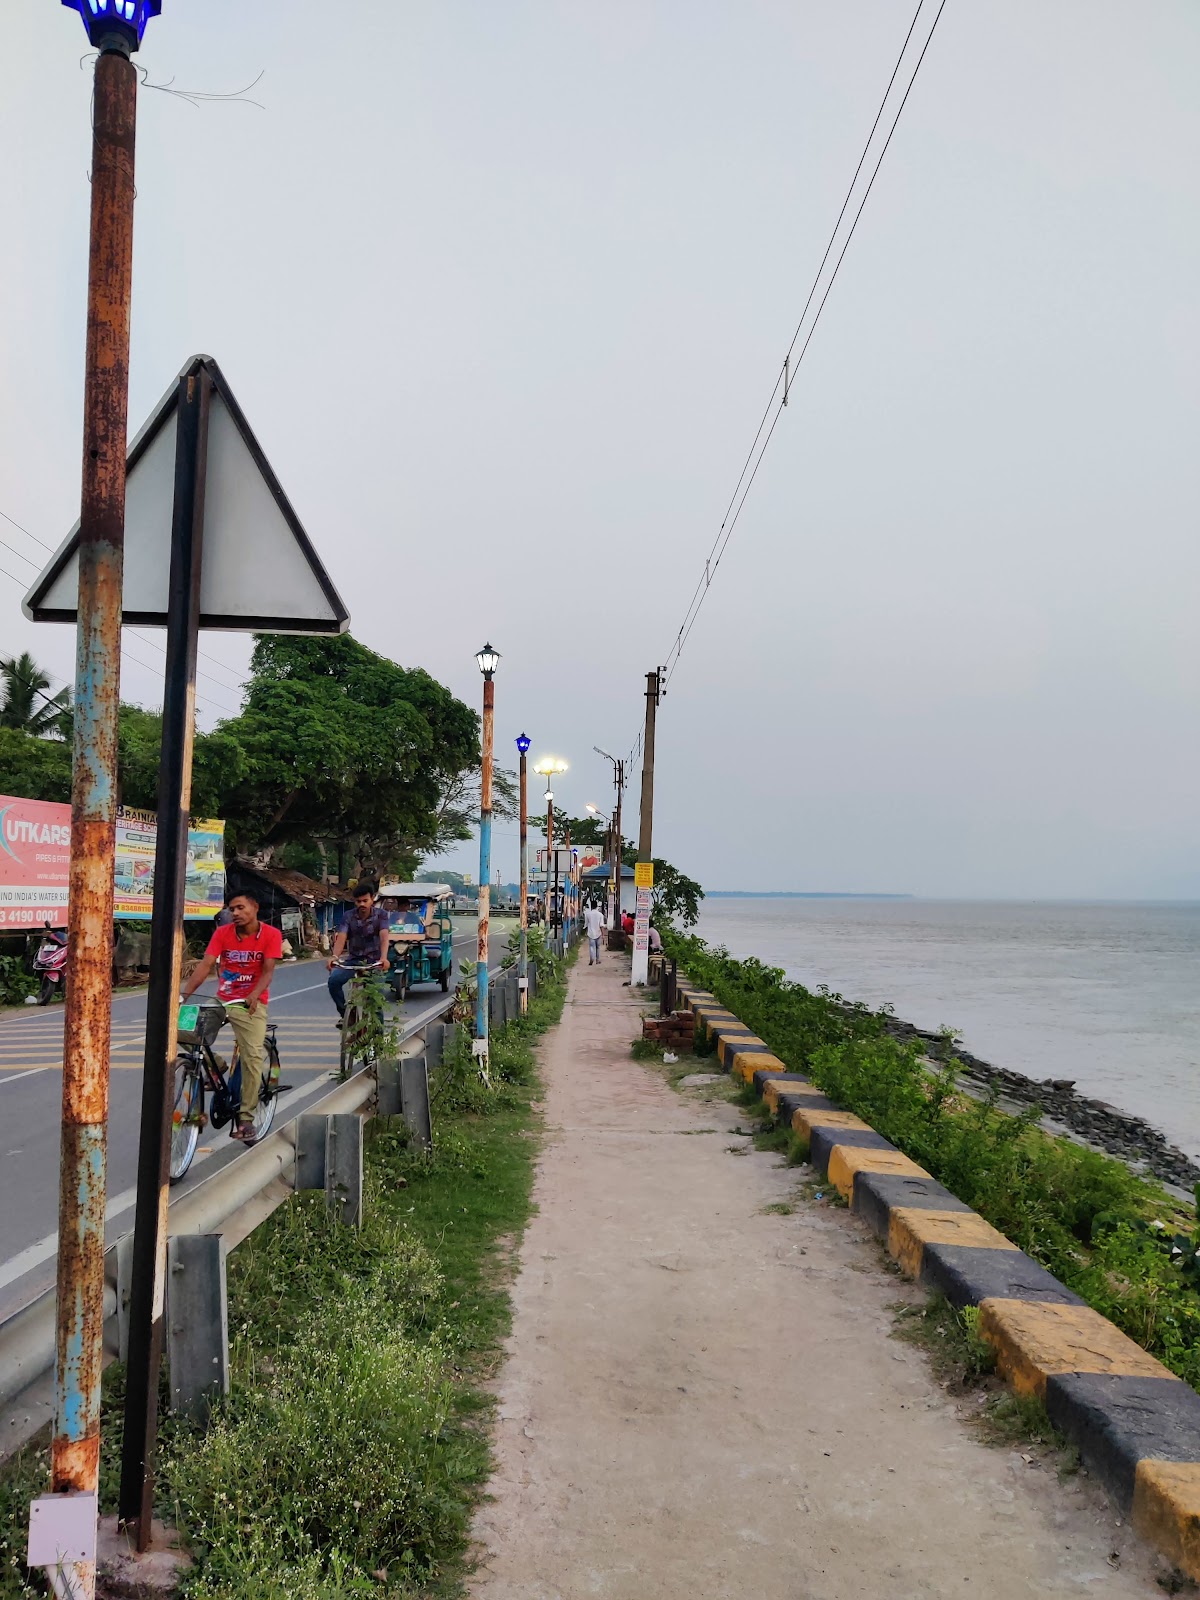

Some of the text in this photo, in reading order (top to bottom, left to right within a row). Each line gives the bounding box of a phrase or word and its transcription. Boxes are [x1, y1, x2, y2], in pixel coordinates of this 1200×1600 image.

[116, 804, 158, 824] BRAINIA
[6, 819, 71, 846] UTKARS
[35, 853, 52, 863] PIPES
[14, 892, 37, 901] INDIA'S
[38, 892, 59, 901] WATER
[8, 910, 34, 922] 4190
[35, 909, 59, 922] 0001
